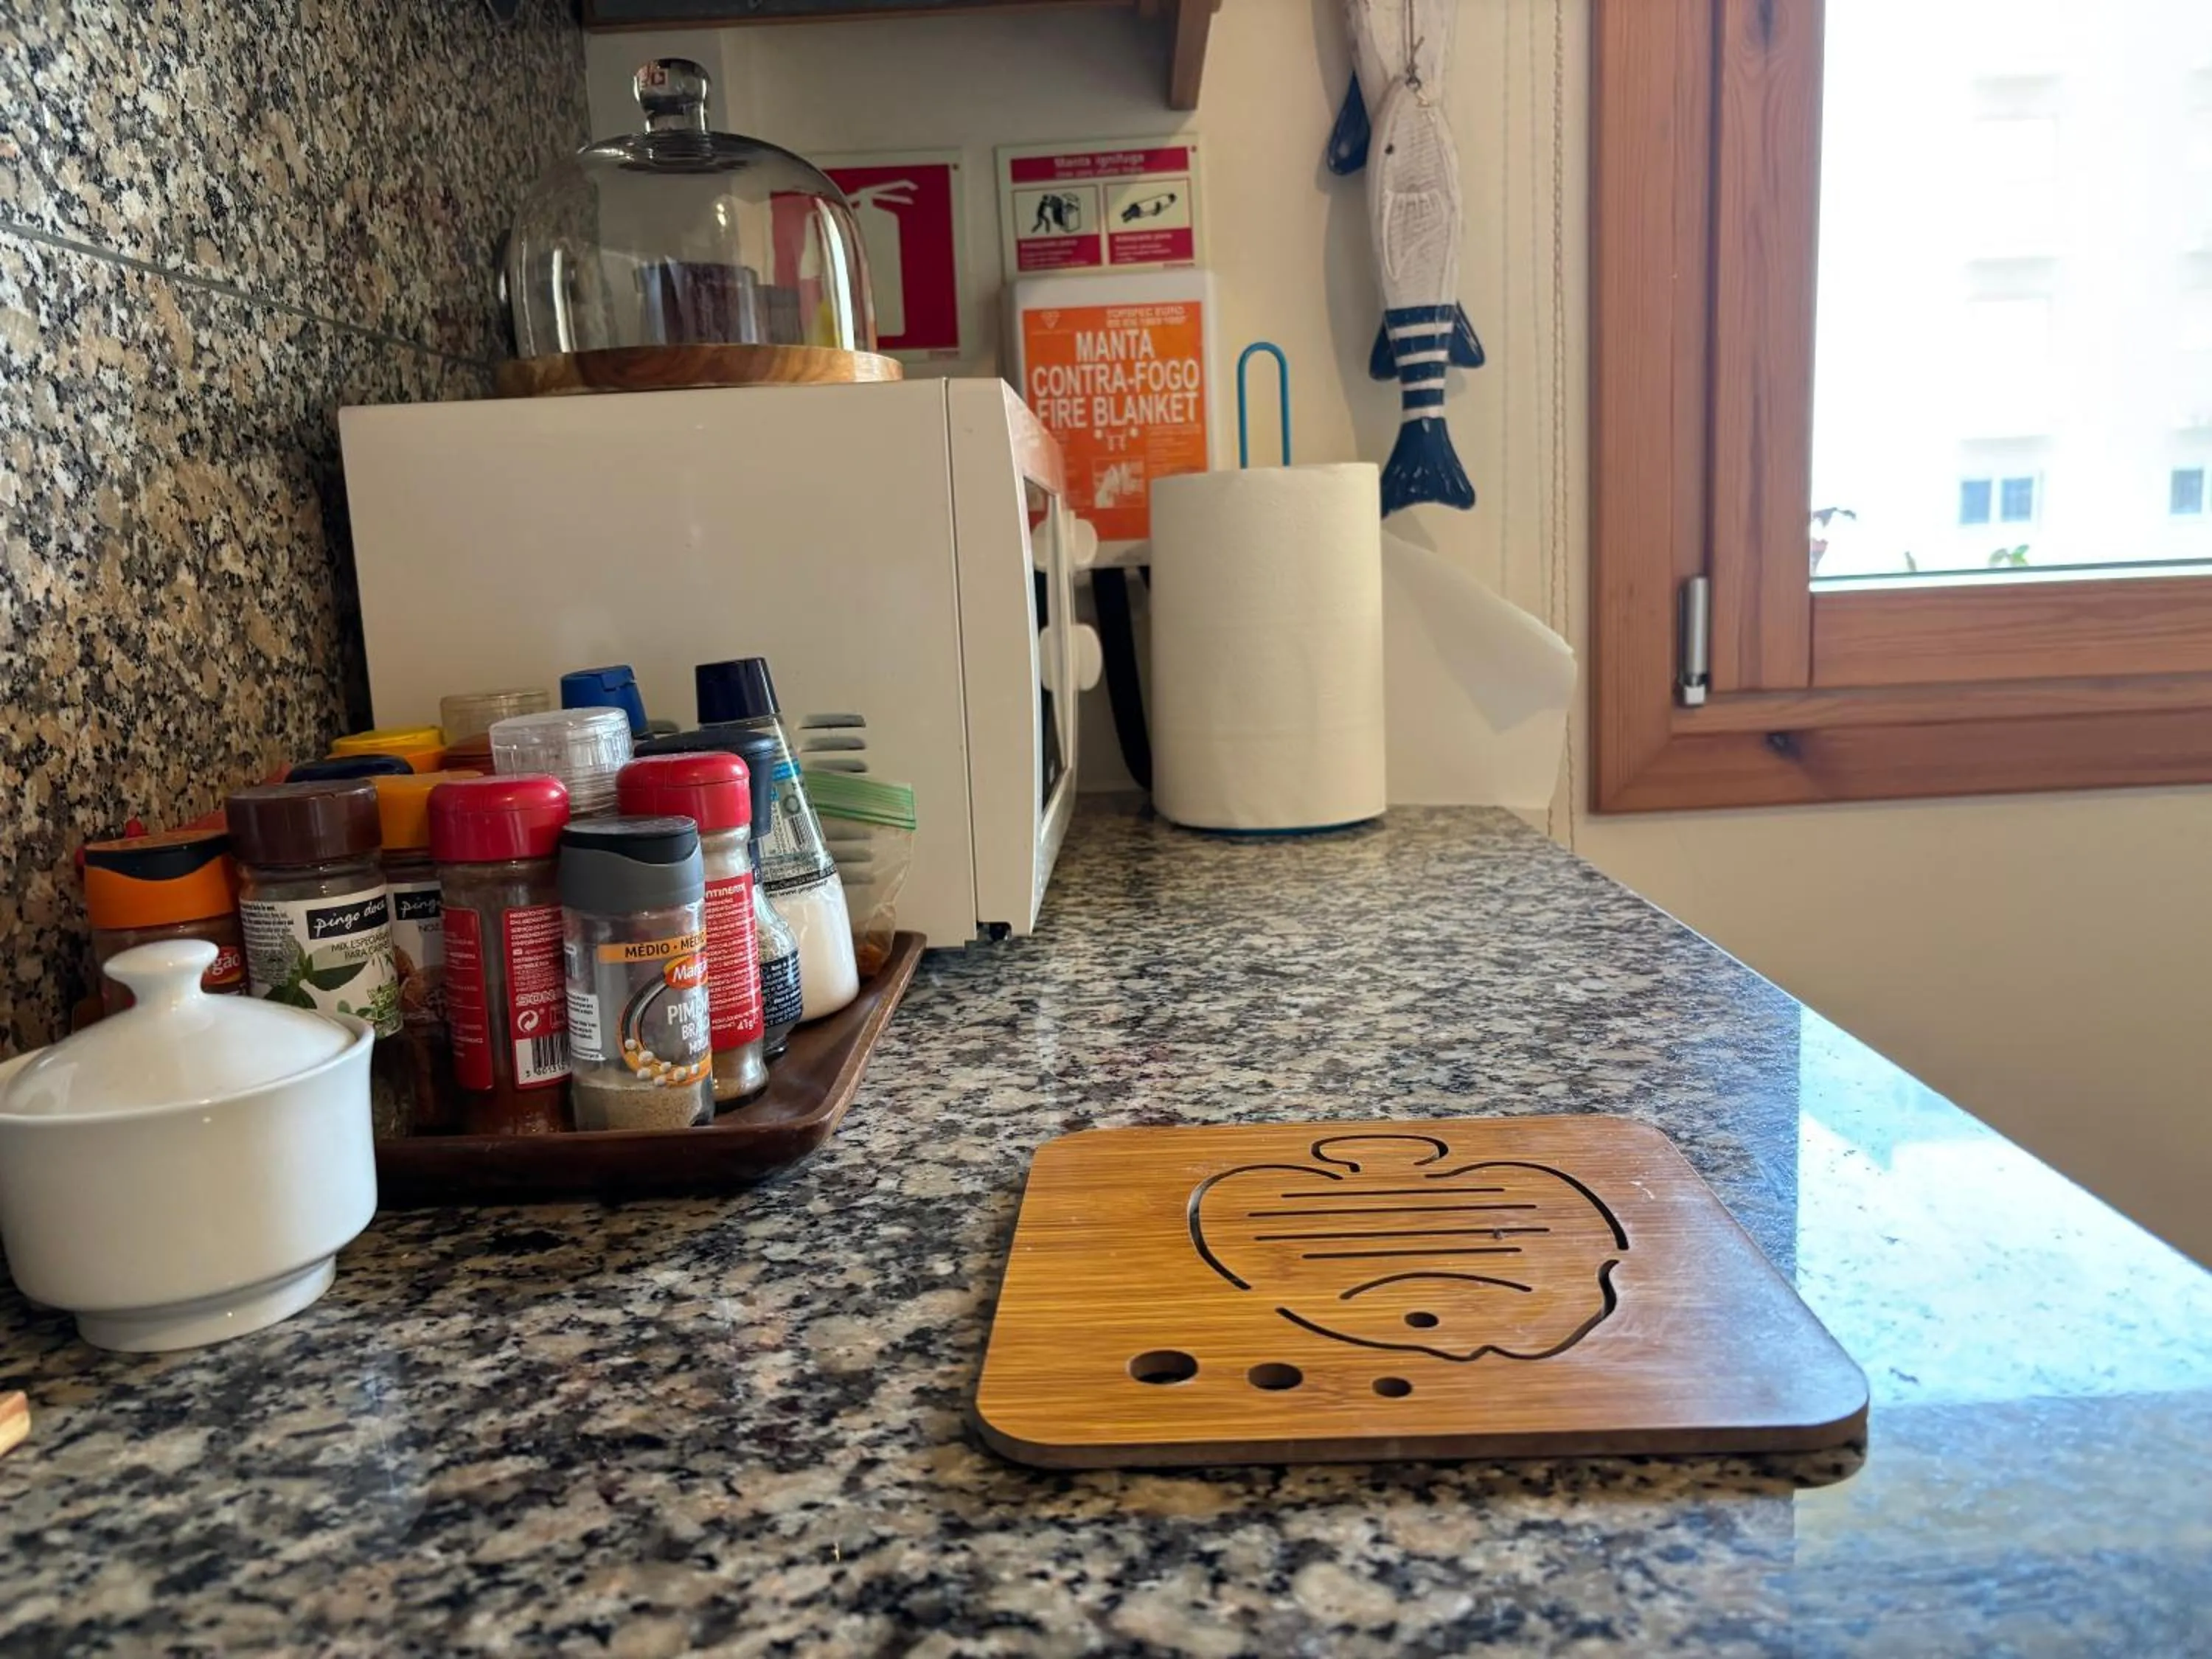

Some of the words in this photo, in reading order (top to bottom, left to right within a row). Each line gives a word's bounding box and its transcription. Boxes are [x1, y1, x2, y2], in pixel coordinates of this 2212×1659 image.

[1076, 329, 1155, 363] MANTA
[1032, 360, 1200, 397] CONTRA-FOGO
[1037, 397, 1087, 428] FIRE
[1093, 392, 1200, 428] BLANKET
[313, 911, 360, 937] pingo
